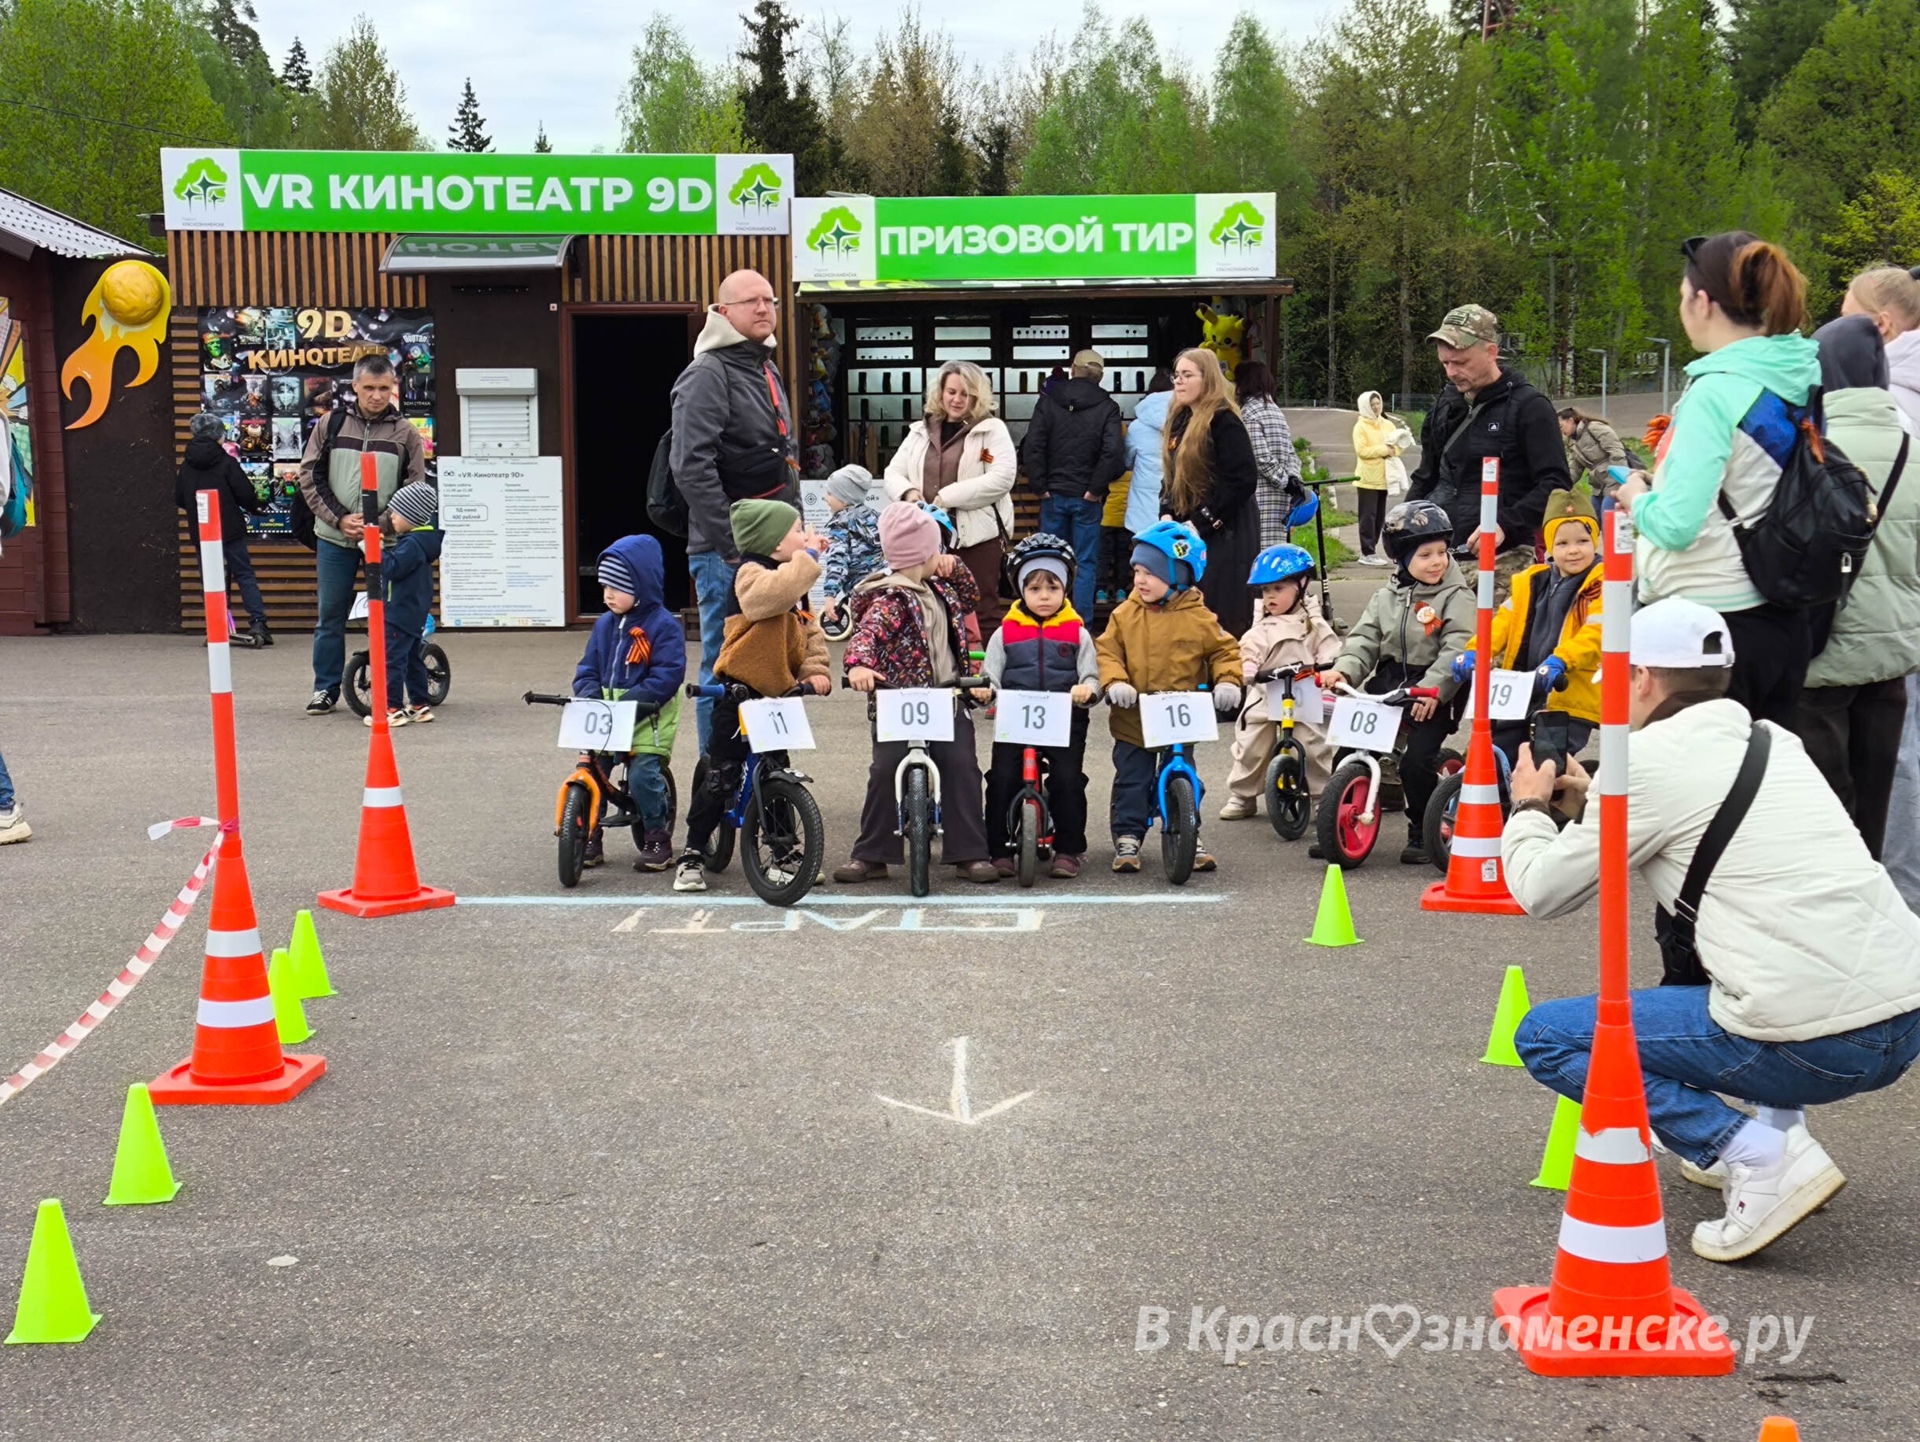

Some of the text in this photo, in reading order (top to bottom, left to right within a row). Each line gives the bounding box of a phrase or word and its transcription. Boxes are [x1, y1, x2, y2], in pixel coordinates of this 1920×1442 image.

[244, 173, 712, 213] VR КИНОТЕАТР 9D
[880, 215, 1193, 255] ПРИЗОВОЙ ТИР
[297, 309, 352, 339] 9D
[1490, 683, 1512, 706] 19
[584, 711, 612, 735] 03
[768, 711, 788, 735] 11
[901, 701, 929, 725] 09
[1022, 704, 1046, 730] 13
[1165, 703, 1191, 728] 16
[1350, 710, 1378, 734] 08
